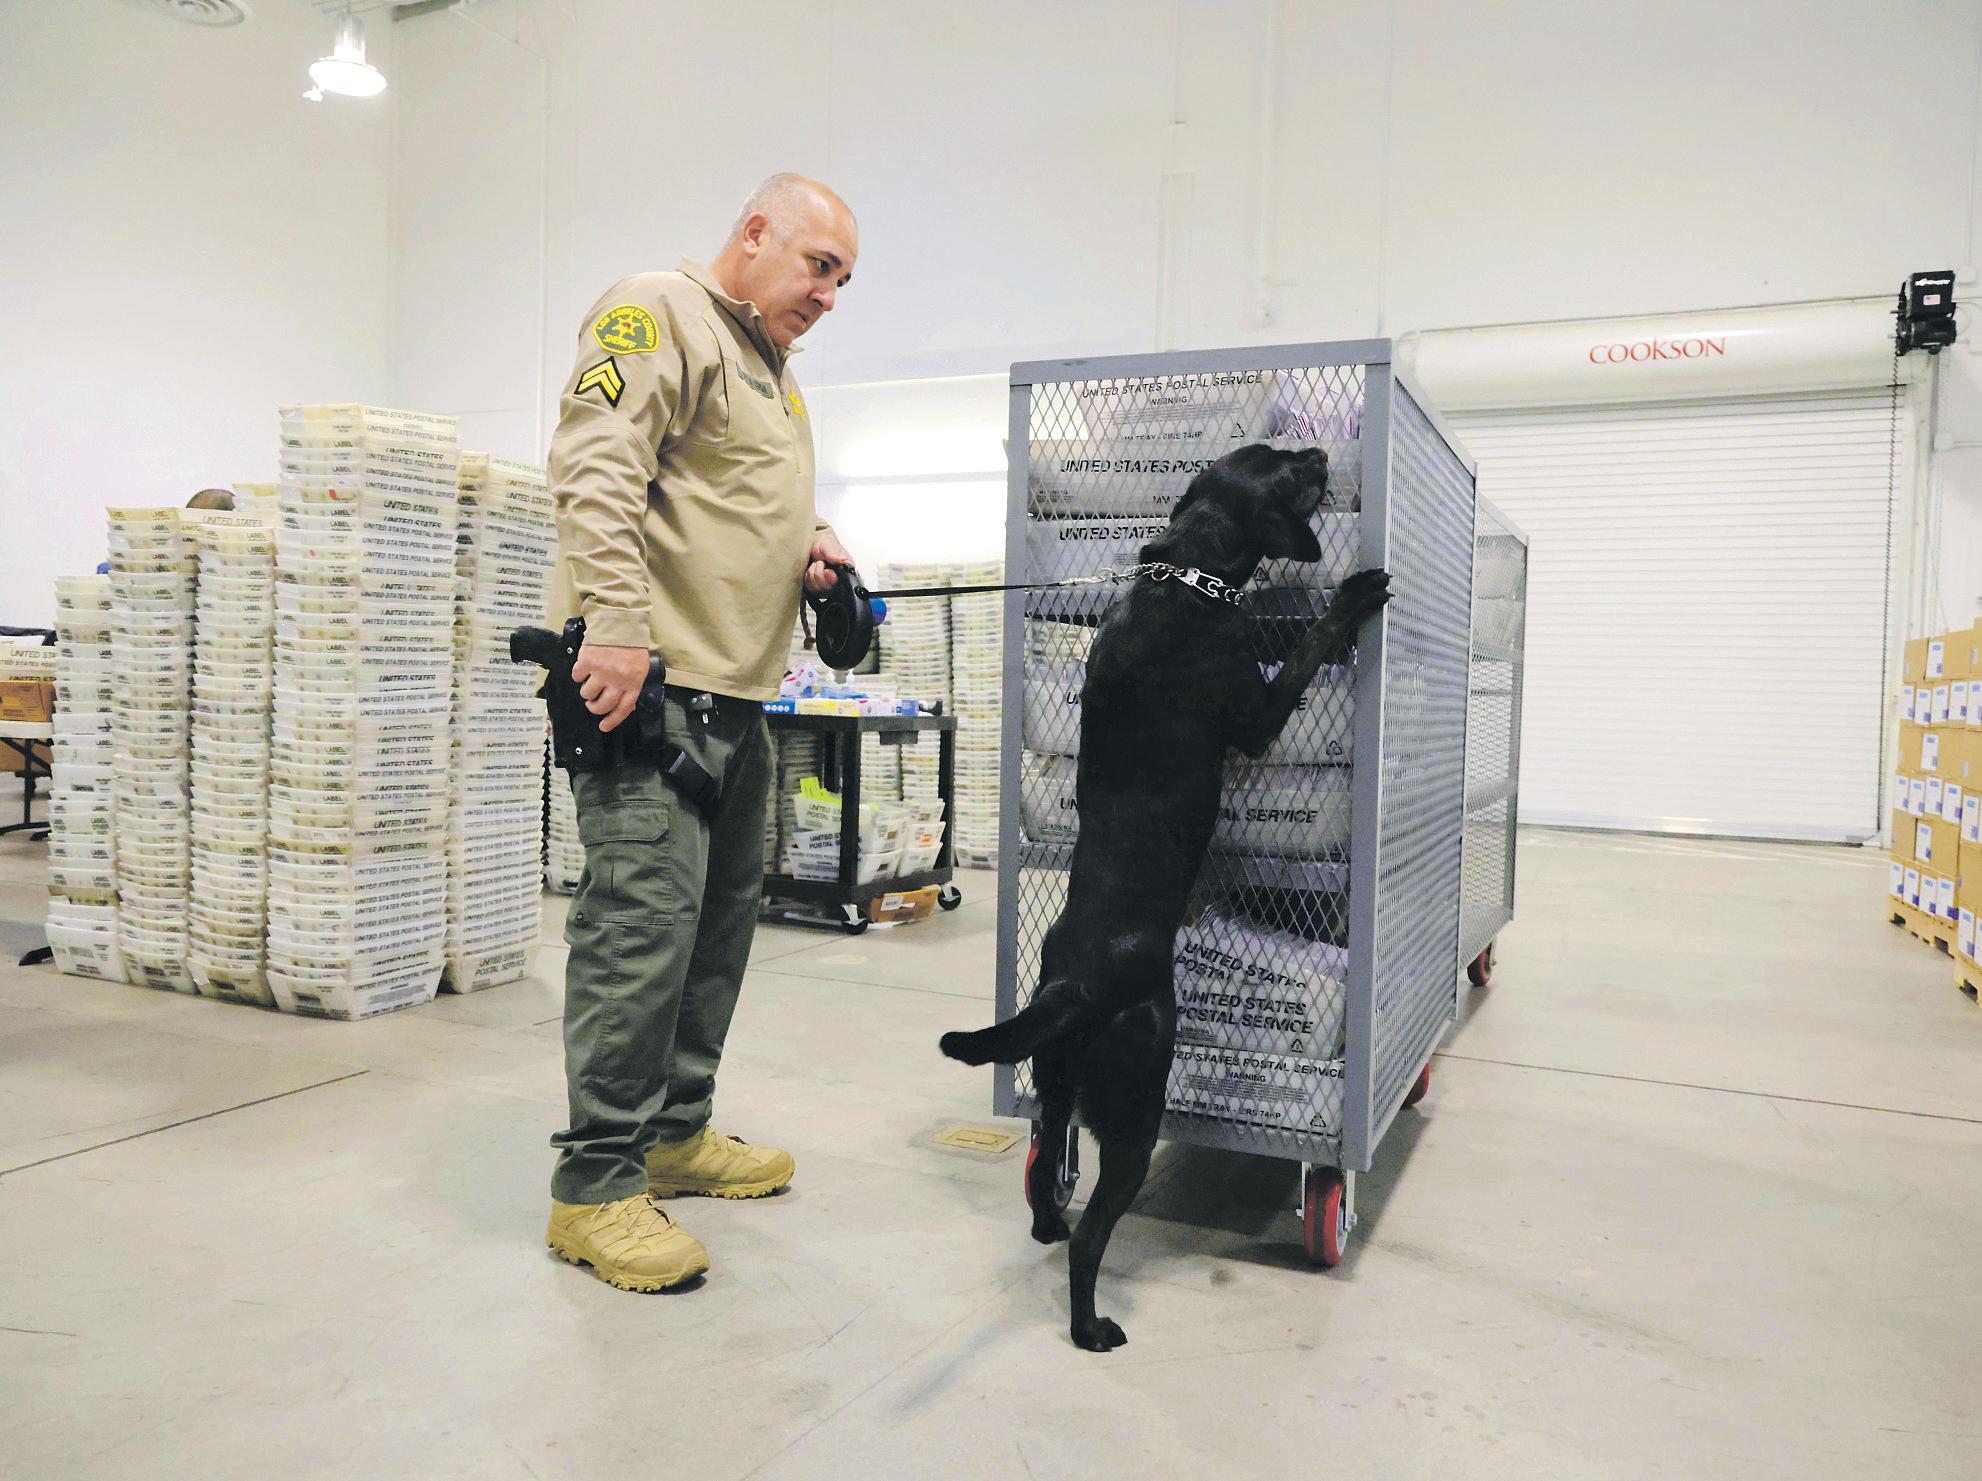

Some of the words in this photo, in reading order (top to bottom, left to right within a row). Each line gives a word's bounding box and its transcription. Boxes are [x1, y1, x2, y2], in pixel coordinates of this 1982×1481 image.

[642, 318, 655, 347] COUNTY
[1589, 337, 1725, 364] COOKSON
[1082, 387, 1118, 398] UNITED
[1123, 382, 1162, 394] STATES
[1061, 460, 1110, 473] UNITED
[1114, 460, 1169, 473] STATES
[384, 500, 411, 511] UNITED
[413, 504, 439, 514] STATES
[1059, 527, 1109, 540] UNITED
[11, 650, 40, 658] UNITED
[1245, 809, 1318, 823] SERVICE
[1184, 941, 1243, 970] UNITED
[1182, 990, 1240, 1008] UNITED
[1244, 997, 1306, 1015] STATES
[1177, 1006, 1239, 1025] POSTAL
[1242, 1014, 1314, 1034] SERVICE
[1196, 1052, 1240, 1065] STATES
[1243, 1058, 1289, 1071] POSTAL
